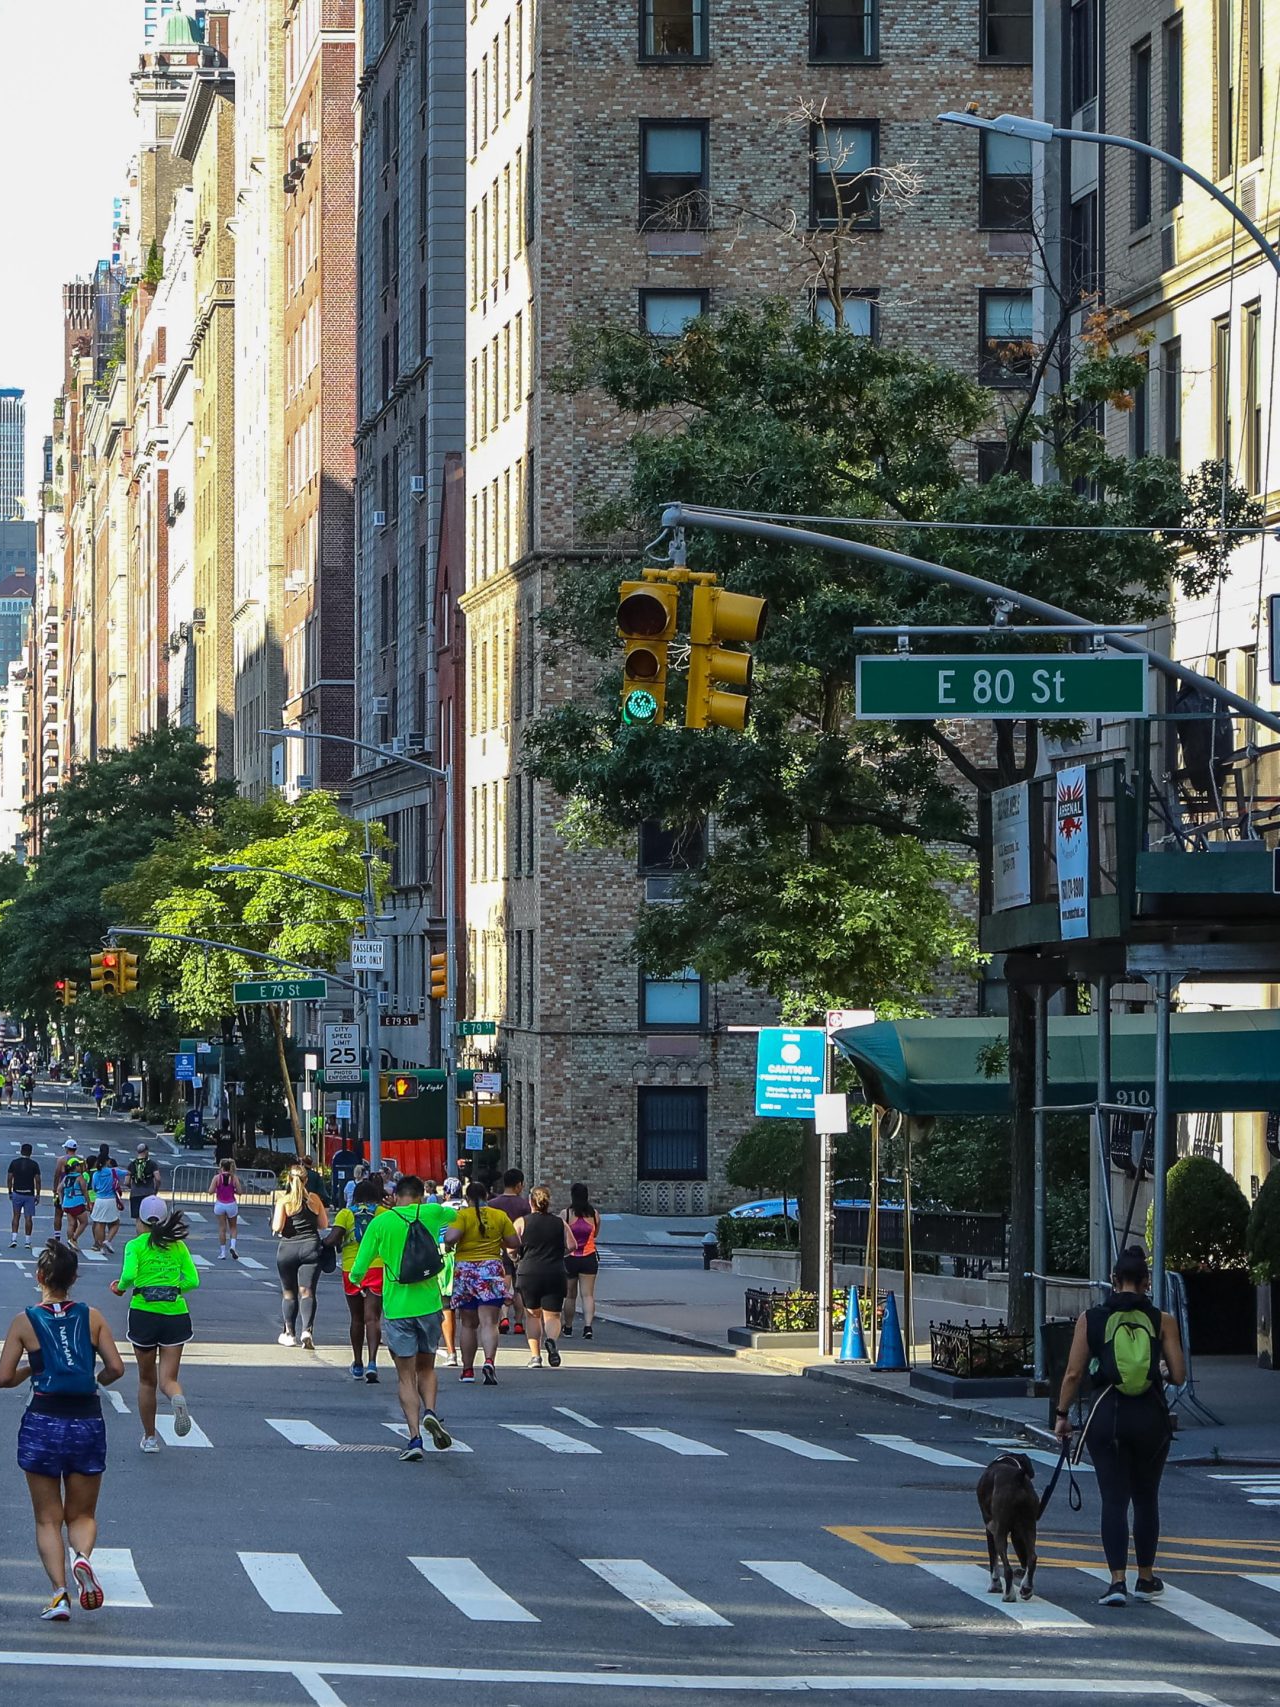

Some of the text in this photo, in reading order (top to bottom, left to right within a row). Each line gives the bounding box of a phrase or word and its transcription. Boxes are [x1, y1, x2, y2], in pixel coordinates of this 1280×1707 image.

[938, 669, 1065, 704] E 80 St
[1059, 801, 1082, 817] ARSENAL
[353, 944, 382, 953] PASSENGER
[353, 955, 382, 965] CARS ONLY
[260, 984, 300, 997] E 79 St
[385, 1016, 412, 1026] E 79 St
[463, 1023, 468, 1034] E
[471, 1023, 482, 1034] 79
[330, 1048, 357, 1064] 25
[768, 1064, 813, 1075] CAUTION
[1116, 1090, 1150, 1105] 910
[59, 1326, 74, 1367] NATHAN
